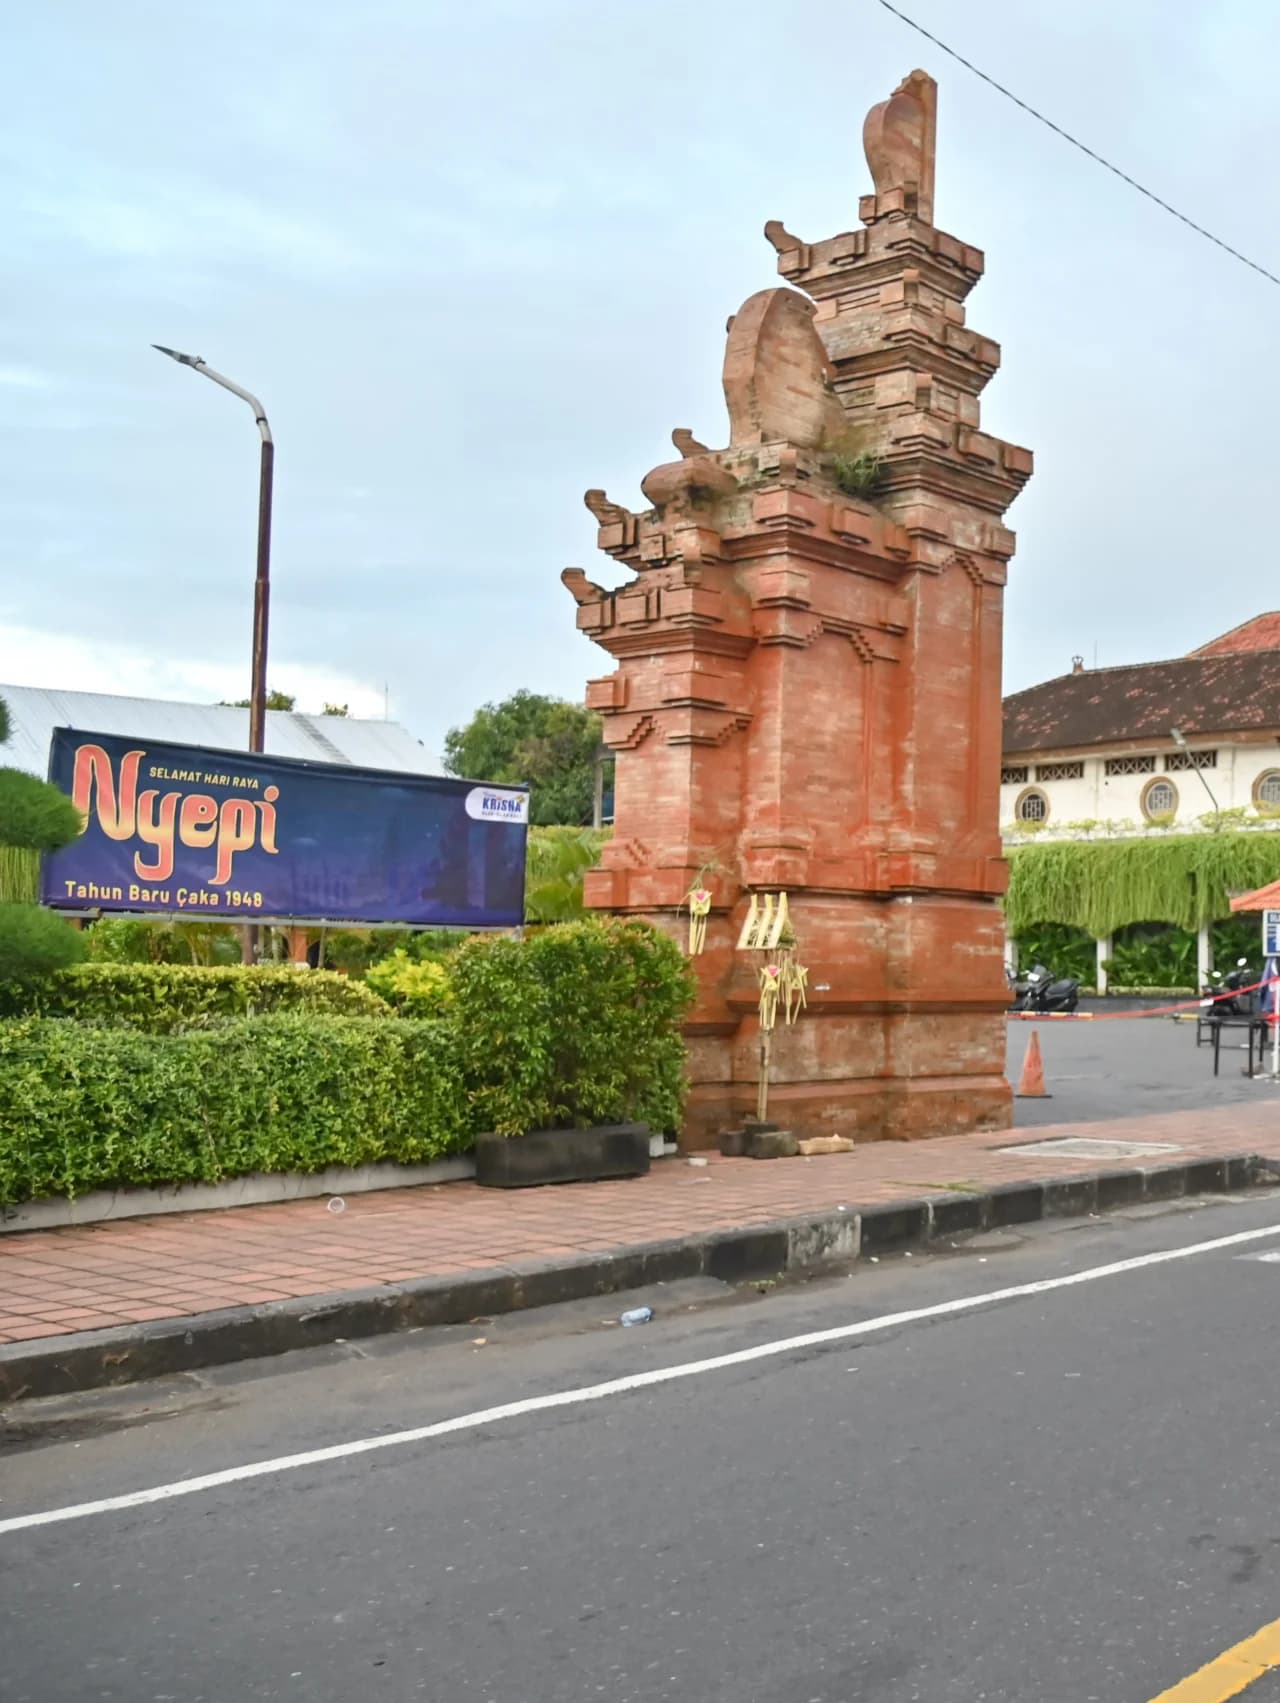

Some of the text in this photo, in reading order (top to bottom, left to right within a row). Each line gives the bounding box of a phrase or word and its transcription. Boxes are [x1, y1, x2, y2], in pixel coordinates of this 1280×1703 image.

[149, 766, 259, 789] SELAMAT HARI RAYA
[72, 744, 280, 885] Nyepi
[65, 880, 263, 908] Tahun Baru Çaka 1948
